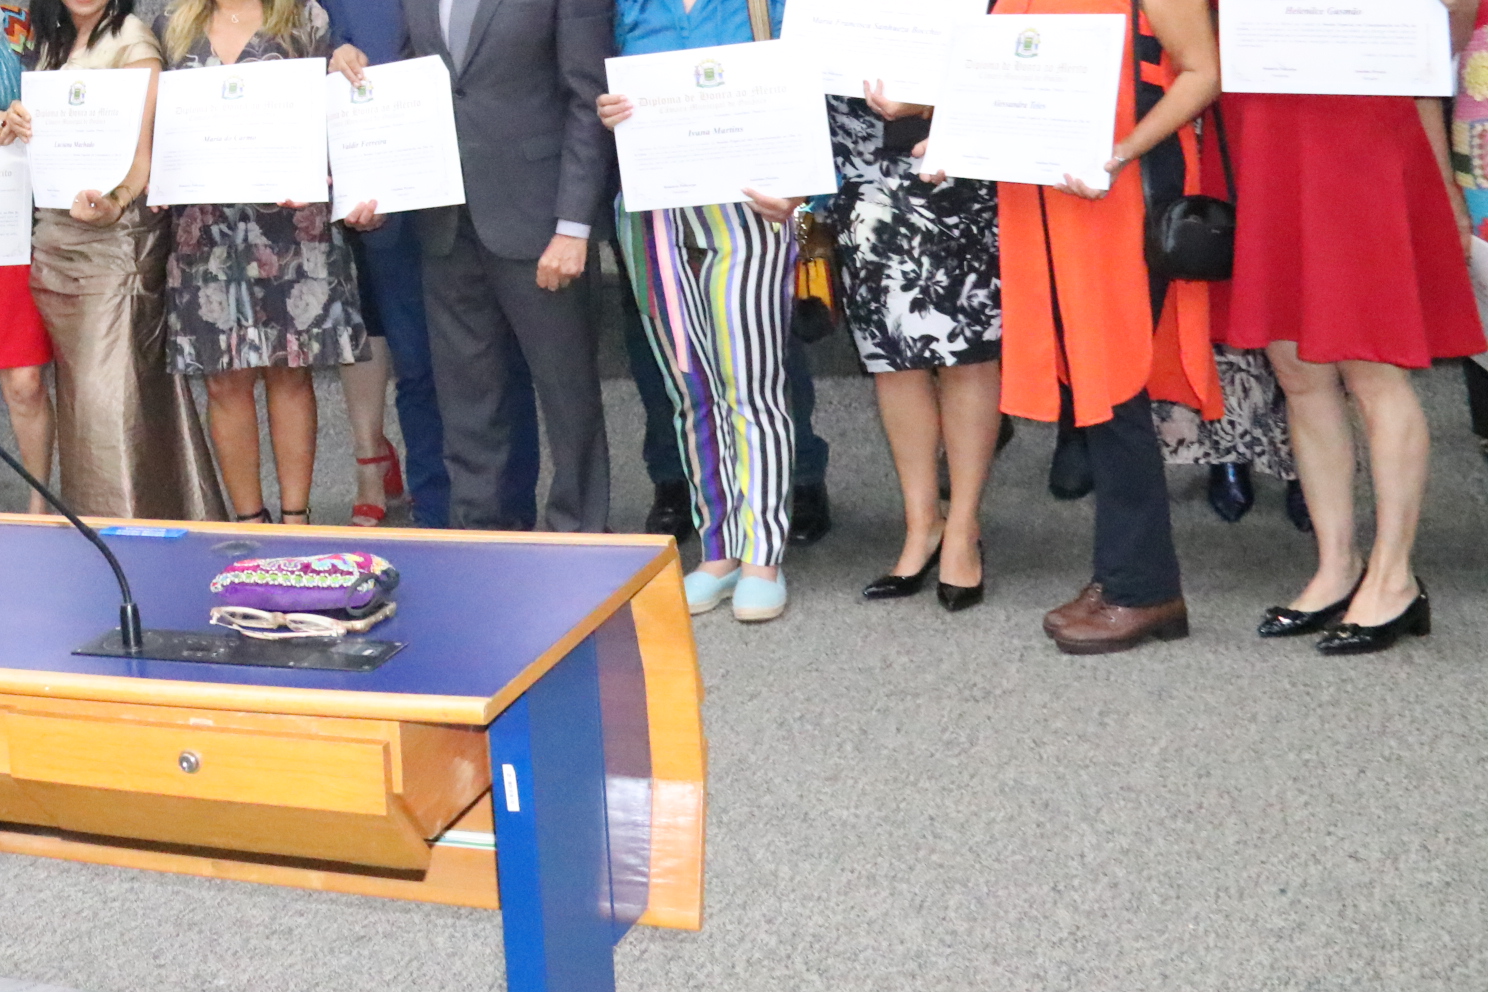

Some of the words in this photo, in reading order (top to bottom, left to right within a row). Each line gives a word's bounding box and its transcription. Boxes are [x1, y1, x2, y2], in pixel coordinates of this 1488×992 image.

[1327, 6, 1362, 15] Gusmão
[638, 96, 681, 107] Diploma
[700, 91, 732, 101] Honra
[751, 85, 787, 95] Mérito
[688, 128, 711, 137] Ivana
[713, 125, 743, 136] Martins
[361, 139, 387, 147] Ferreira
